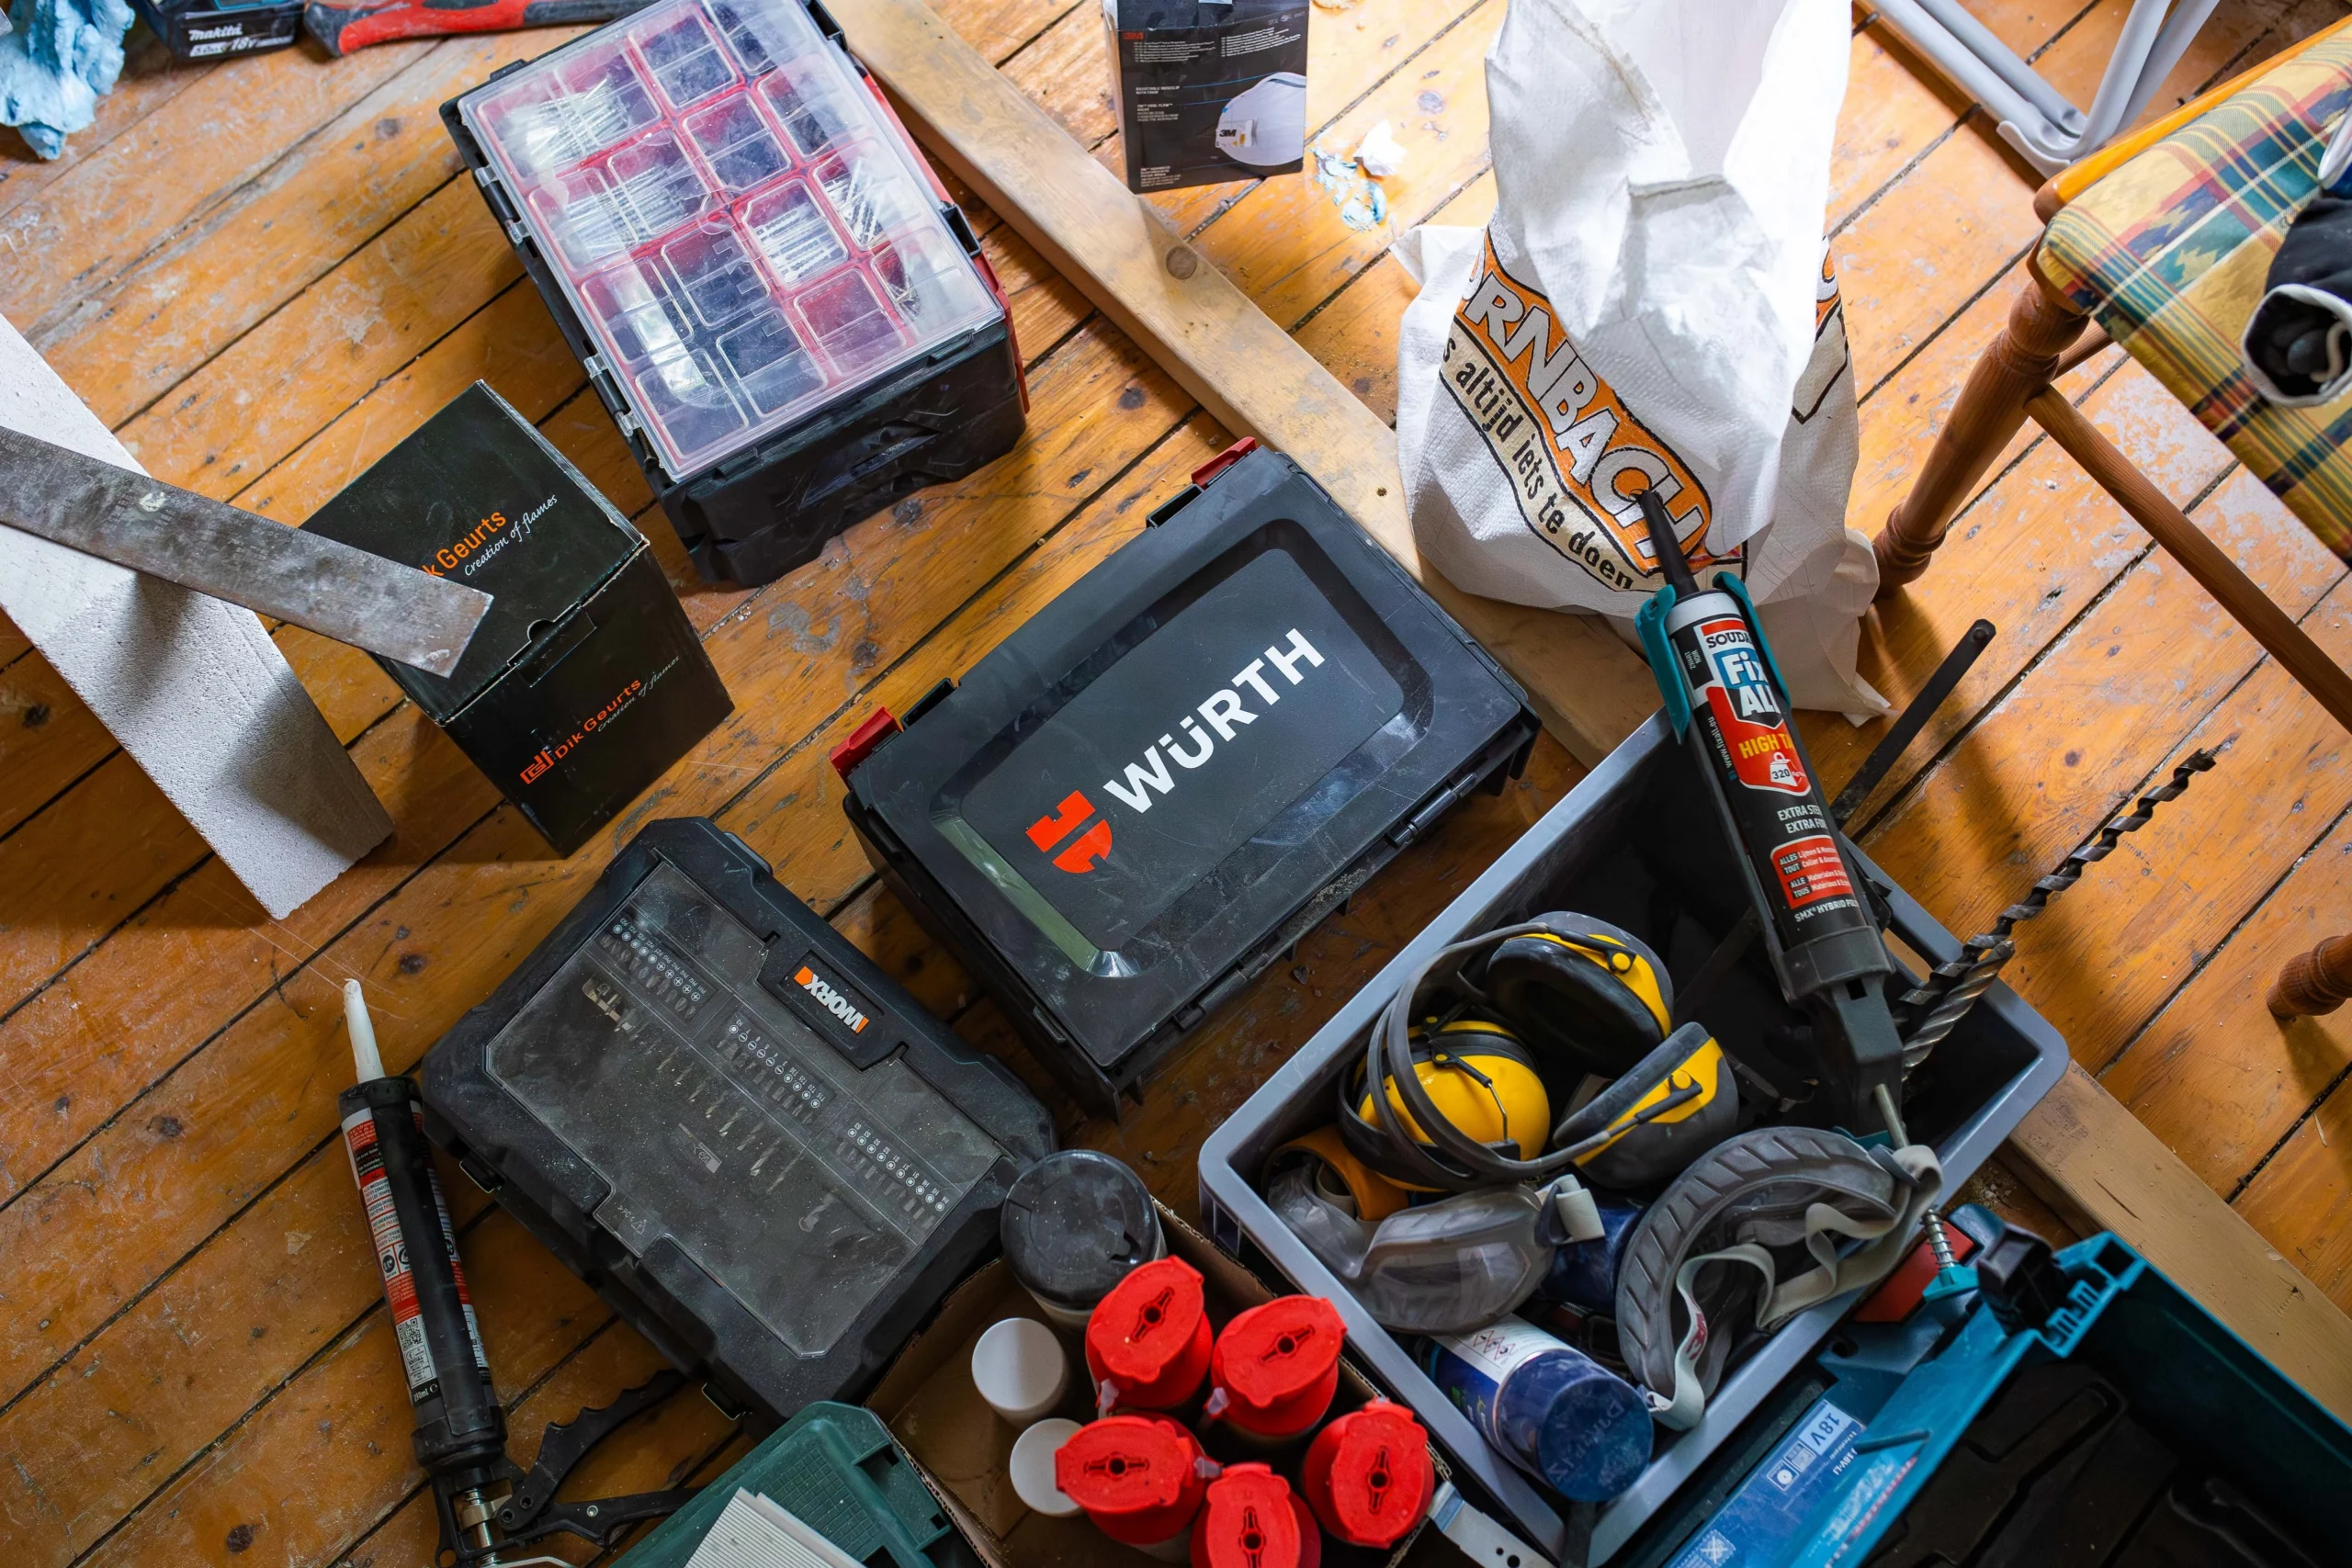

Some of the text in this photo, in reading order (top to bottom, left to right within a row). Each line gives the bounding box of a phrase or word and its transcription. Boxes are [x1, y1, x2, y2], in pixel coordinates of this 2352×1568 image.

[188, 23, 243, 41] makita
[1219, 129, 1237, 138] 3M
[1463, 257, 1704, 558] RNBACH
[1456, 362, 1524, 444] altijd
[1512, 433, 1544, 501] iets
[1538, 498, 1566, 535] te
[1568, 530, 1634, 591] doen
[435, 509, 507, 570] Geurts
[464, 494, 559, 577] Creation of flames
[1705, 631, 1751, 649] SOUDA
[638, 682, 650, 698] of
[649, 654, 680, 691] flames
[554, 679, 641, 760] Dik Geurts
[1102, 628, 1326, 814] WÜRTH
[1707, 716, 1733, 769] www.fixall.eu
[1738, 733, 1795, 759] HIGH TA
[1771, 768, 1791, 780] 320
[1777, 805, 1808, 821] EXTRA
[1785, 819, 1818, 834] EXTRA
[1779, 852, 1799, 865] ALLES
[1783, 863, 1801, 874] TOUT
[1790, 876, 1806, 889] ALLE
[1793, 886, 1811, 898] TOUS
[1816, 899, 1846, 913] HYBRID
[802, 974, 866, 1032] WORX
